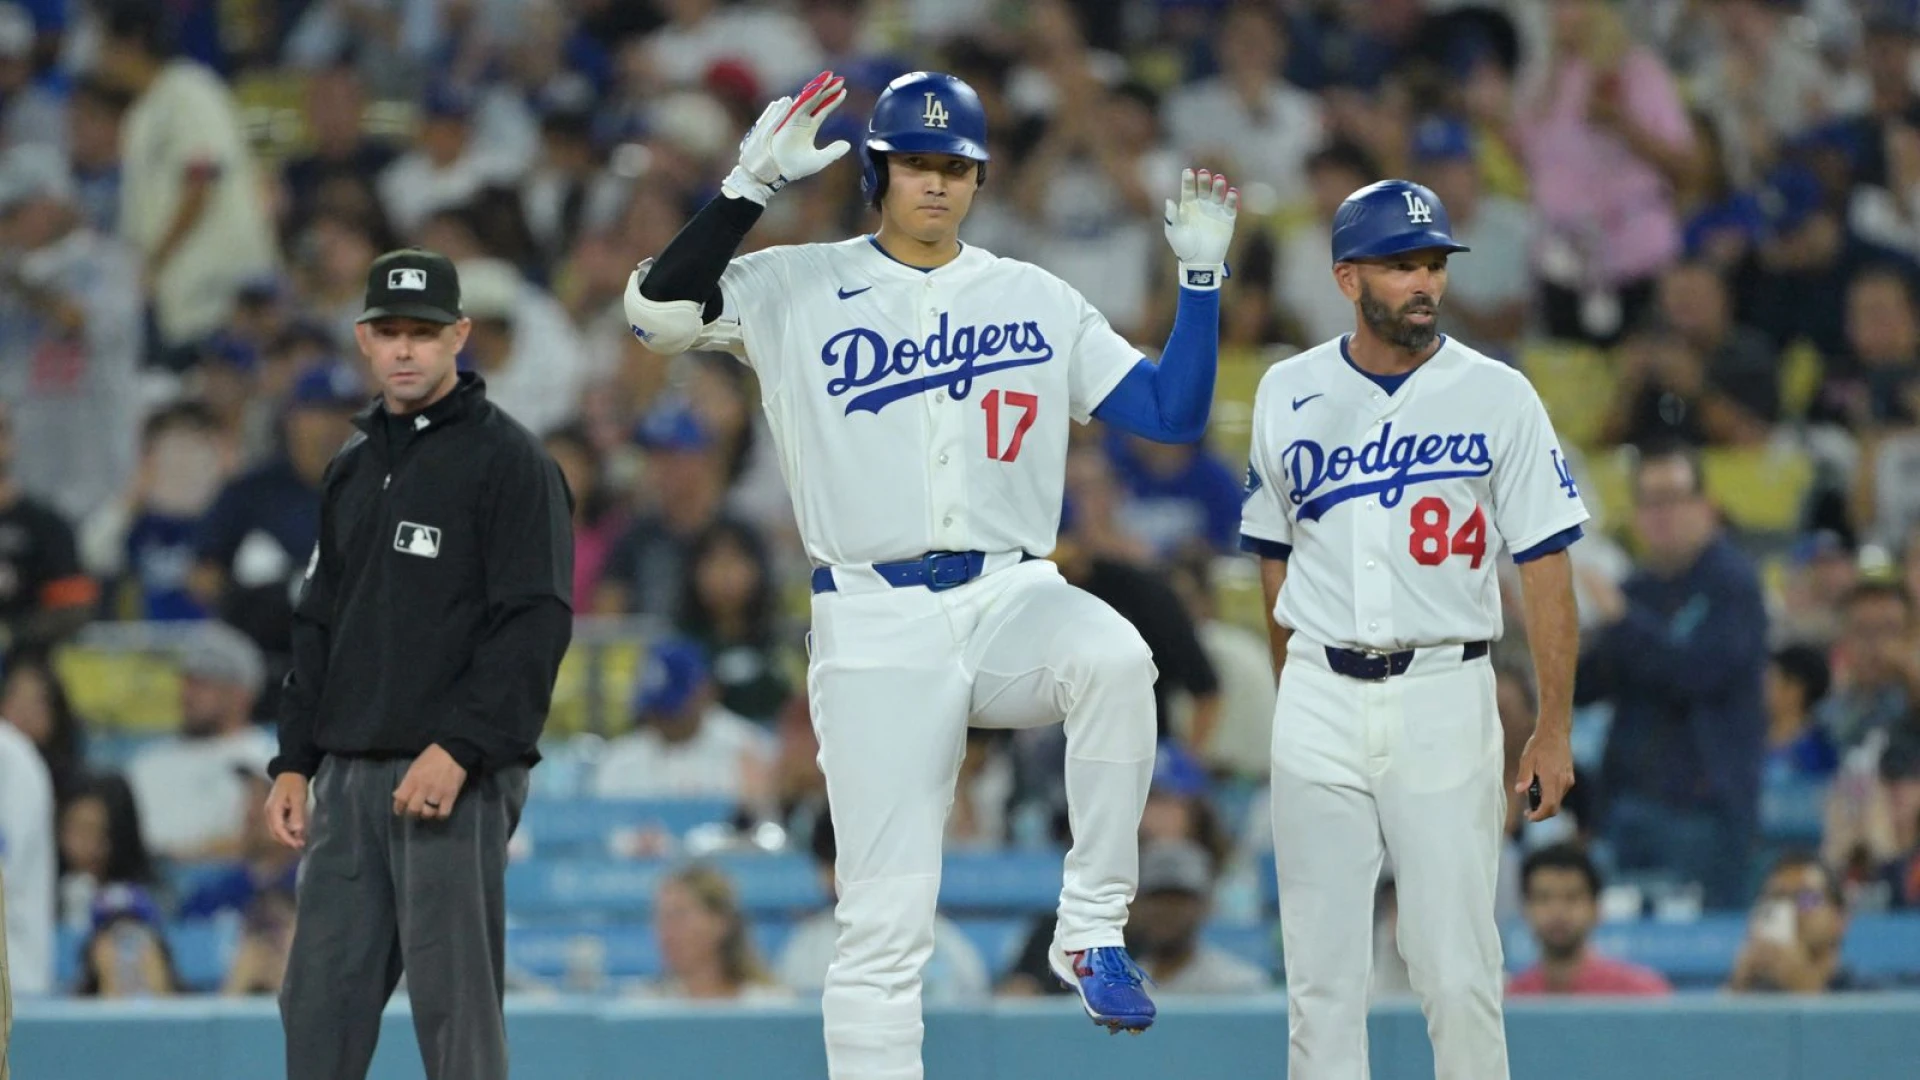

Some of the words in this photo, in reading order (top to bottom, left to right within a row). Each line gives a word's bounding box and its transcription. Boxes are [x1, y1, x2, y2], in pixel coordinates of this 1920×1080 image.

[922, 92, 949, 128] LA
[1401, 191, 1433, 224] LA
[821, 311, 1054, 417] Dodgers
[980, 389, 1038, 463] 17
[1282, 421, 1493, 522] Dodgers
[1409, 496, 1486, 569] 84
